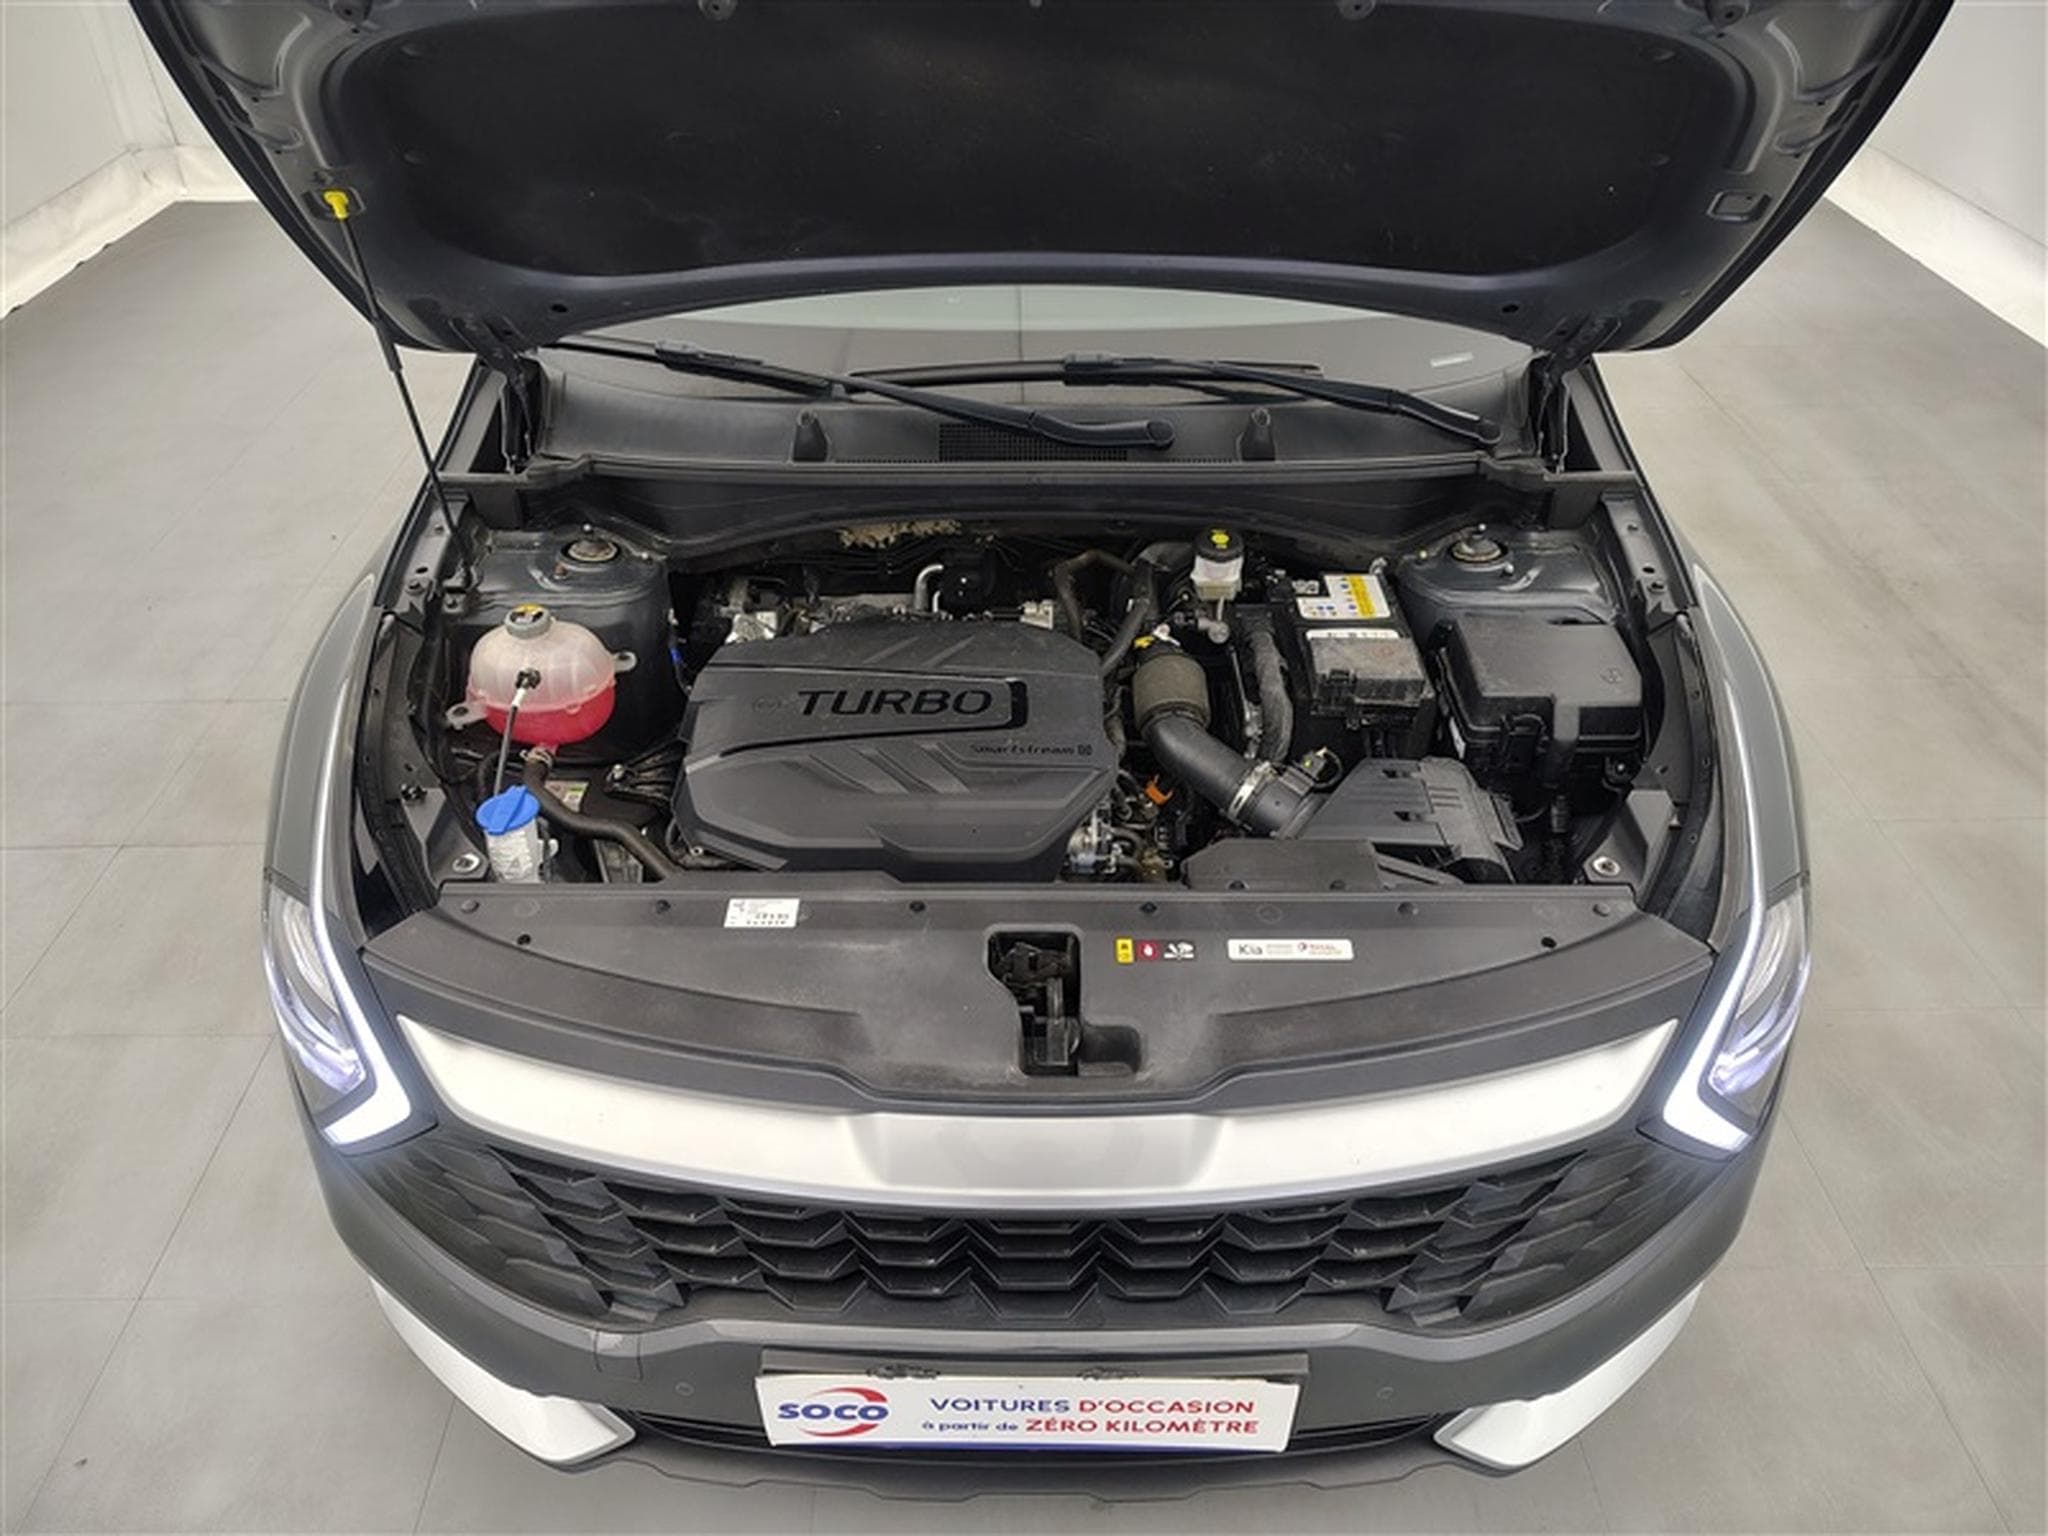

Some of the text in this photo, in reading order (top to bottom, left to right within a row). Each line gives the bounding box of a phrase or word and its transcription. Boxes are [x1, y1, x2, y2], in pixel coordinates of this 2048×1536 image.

[798, 689, 993, 716] TURBO
[1238, 943, 1263, 956] Kia
[777, 1403, 889, 1420] SOCO
[930, 1398, 1254, 1413] VOITURES D'OCCASION
[939, 1421, 989, 1432] partir
[995, 1422, 1019, 1431] de
[1026, 1418, 1098, 1432] ZÉRO
[1105, 1418, 1260, 1433] KILOMÈTRE
